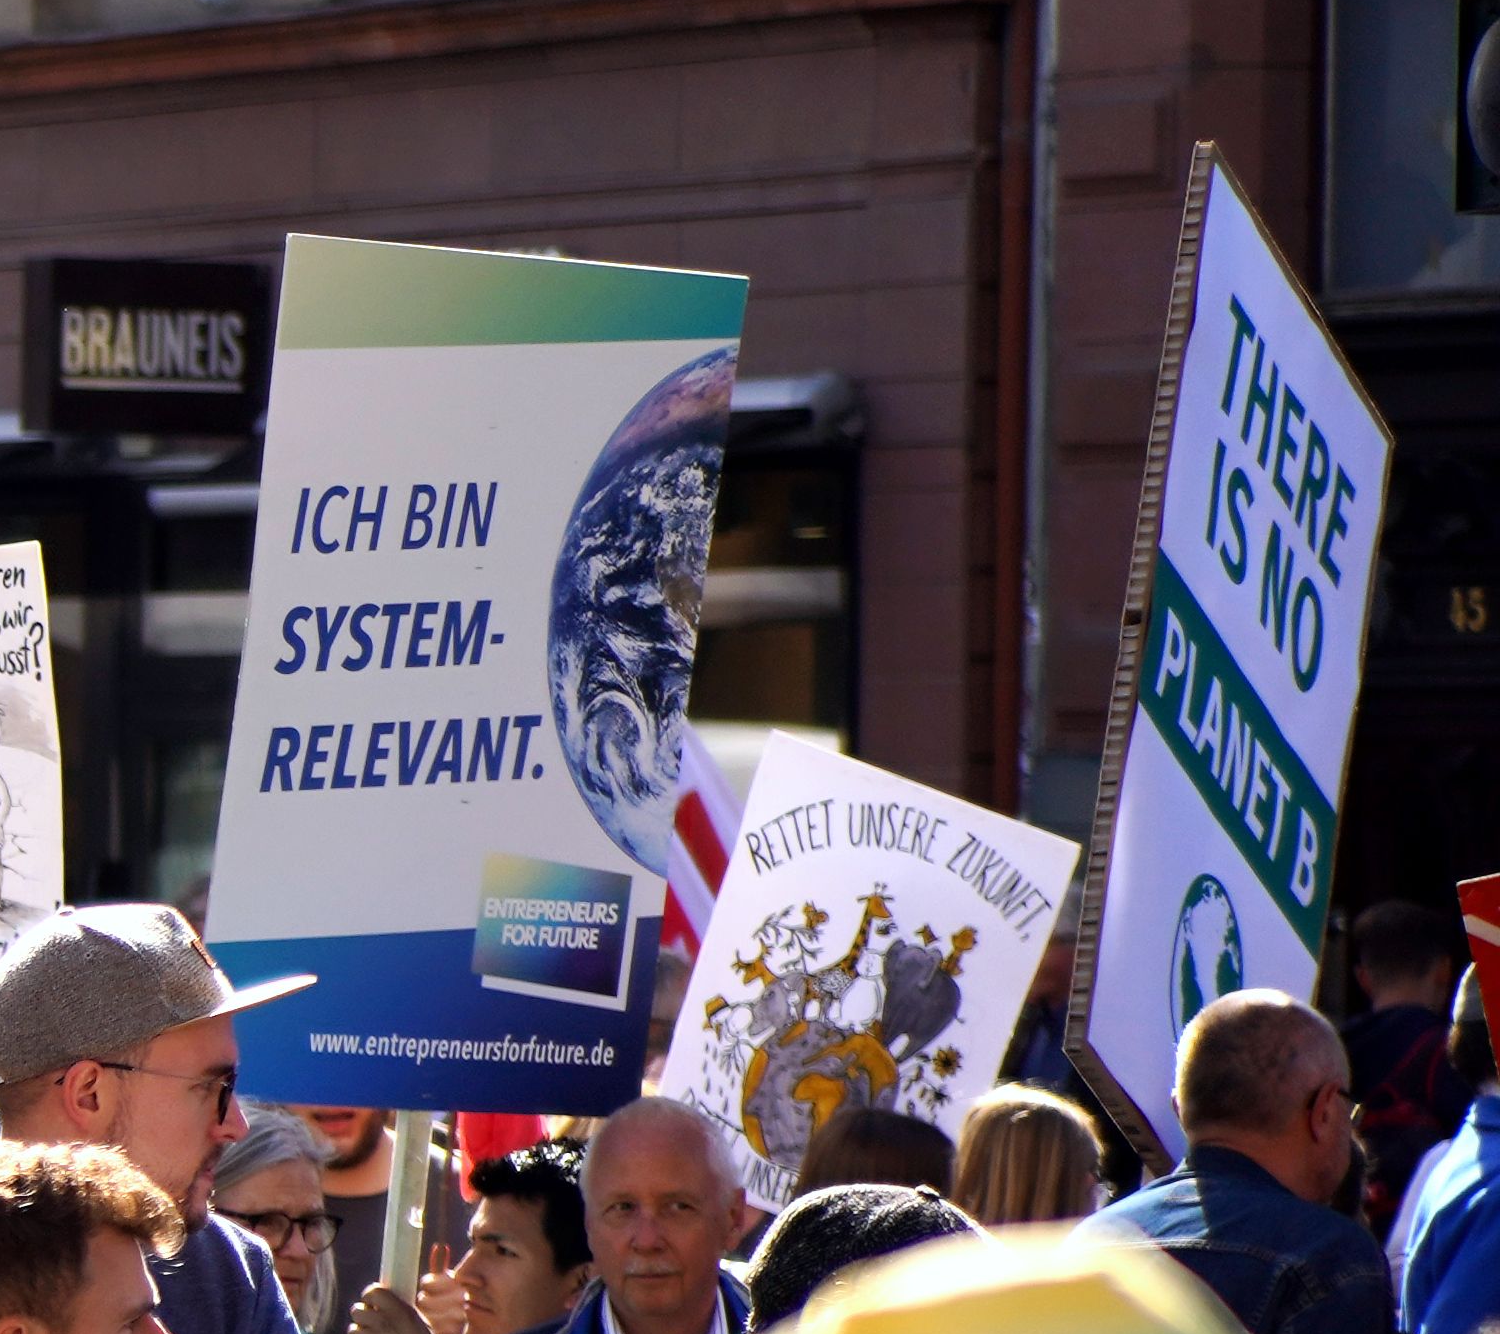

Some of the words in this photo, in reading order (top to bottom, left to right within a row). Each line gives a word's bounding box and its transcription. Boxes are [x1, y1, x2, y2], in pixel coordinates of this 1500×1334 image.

[61, 306, 244, 377] BRAUNEIS
[1221, 292, 1357, 589] THERE
[290, 485, 389, 554] ICH
[400, 481, 498, 551] BIN
[1205, 438, 1255, 585] IS
[1260, 519, 1324, 693] NO
[273, 600, 505, 675] SYSTEM-
[259, 715, 544, 793] RELEVANT.
[1154, 606, 1291, 859] PLANET
[1291, 805, 1319, 908] B
[745, 798, 835, 876] RETTET
[847, 802, 949, 865] UNSERE
[484, 897, 619, 925] ENTREPRENEURS
[501, 923, 536, 946] FOR
[538, 926, 600, 950] FUTURE
[309, 1032, 615, 1067] www.entrepreneursforfuture.de
